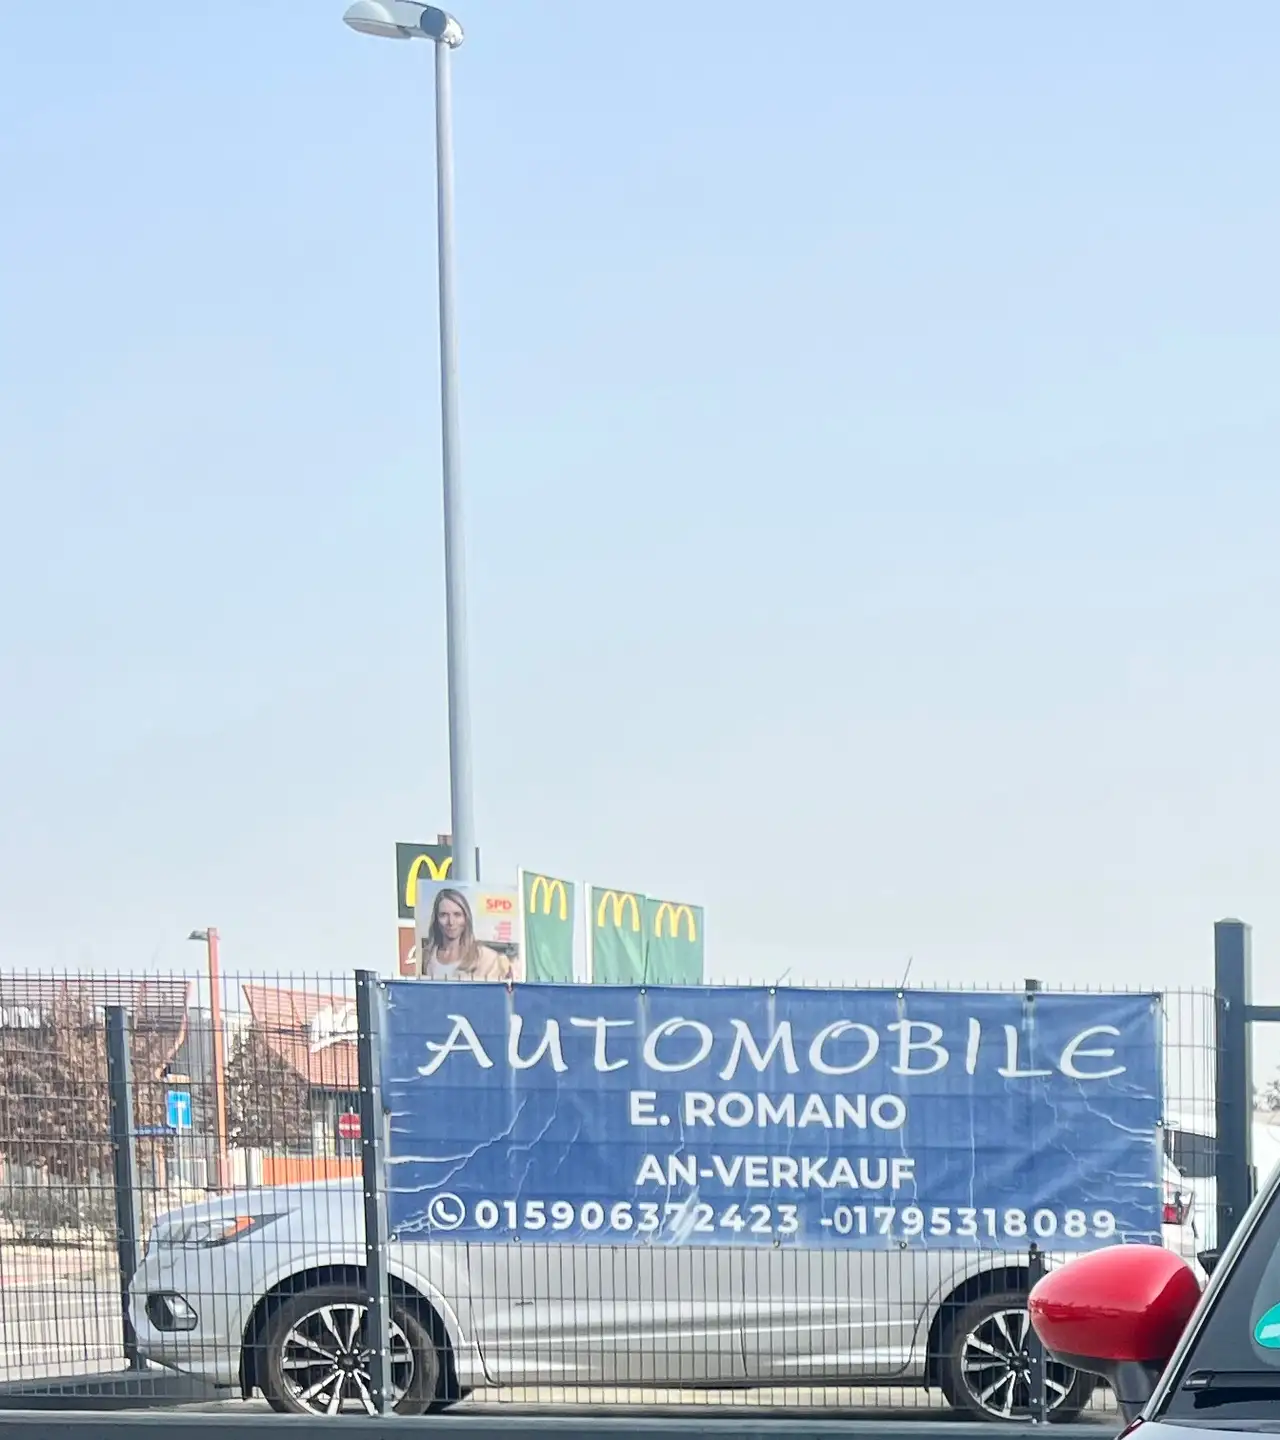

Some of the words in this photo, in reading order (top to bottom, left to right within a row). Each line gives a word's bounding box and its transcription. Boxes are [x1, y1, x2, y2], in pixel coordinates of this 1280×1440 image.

[485, 898, 512, 911] SPD
[417, 1014, 1127, 1080] AUTOMOBILE
[629, 1090, 671, 1127] E.
[684, 1091, 907, 1131] ROMANO
[635, 1153, 916, 1190] AN-VERKAUF
[475, 1199, 800, 1233] 015906372423
[821, 1205, 1117, 1239] -01795318089
